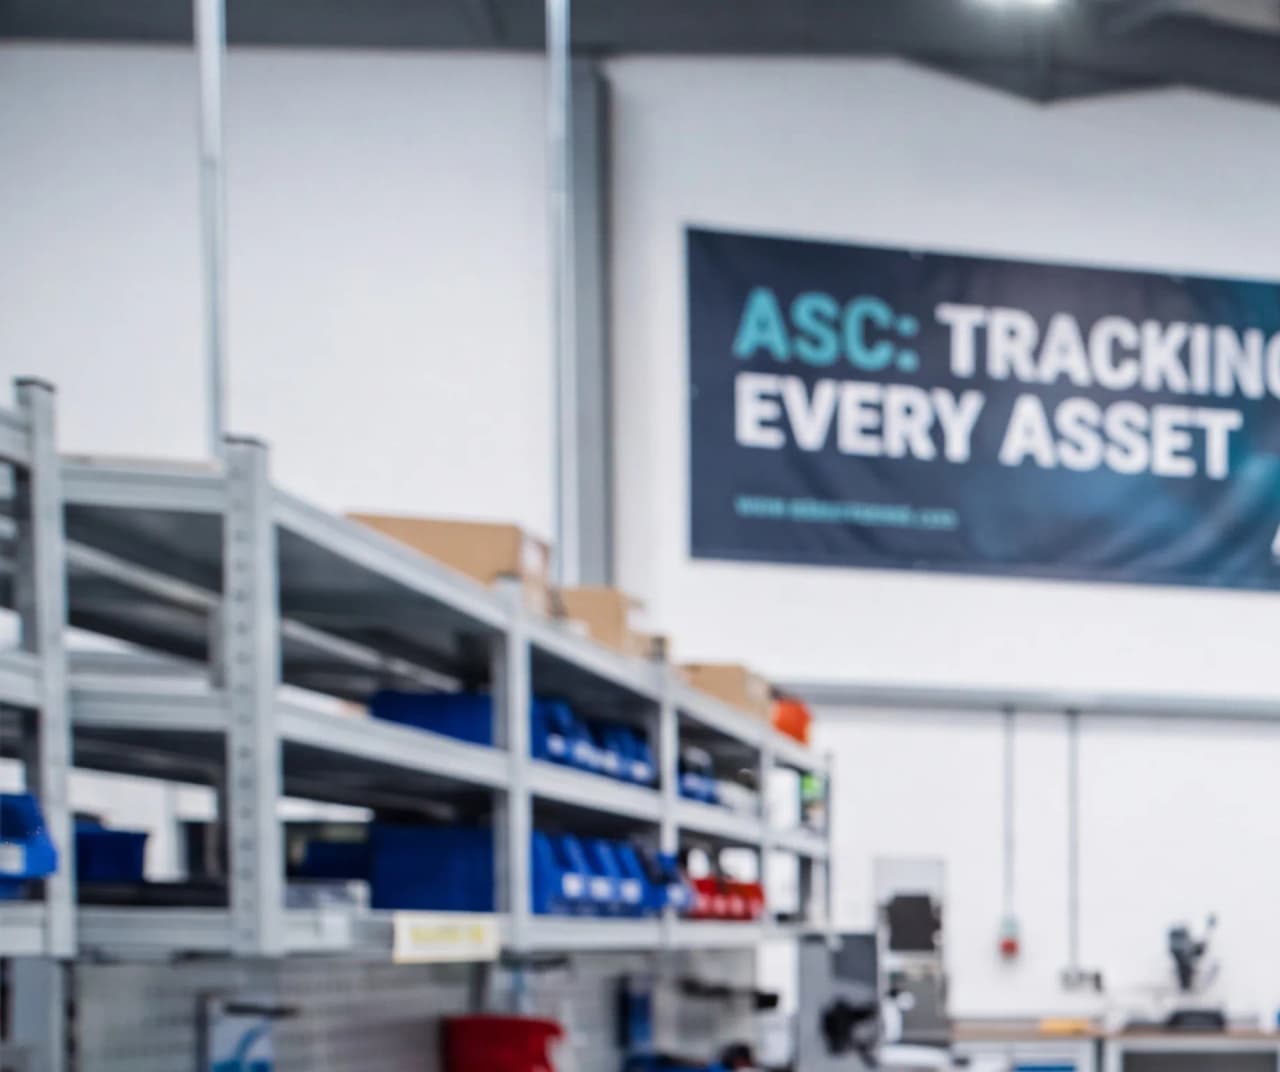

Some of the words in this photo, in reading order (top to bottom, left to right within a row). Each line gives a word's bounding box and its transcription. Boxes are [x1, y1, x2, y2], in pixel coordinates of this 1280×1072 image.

[734, 286, 920, 373] ASC:
[734, 371, 985, 464] EVERY
[998, 393, 1244, 480] ASSET
